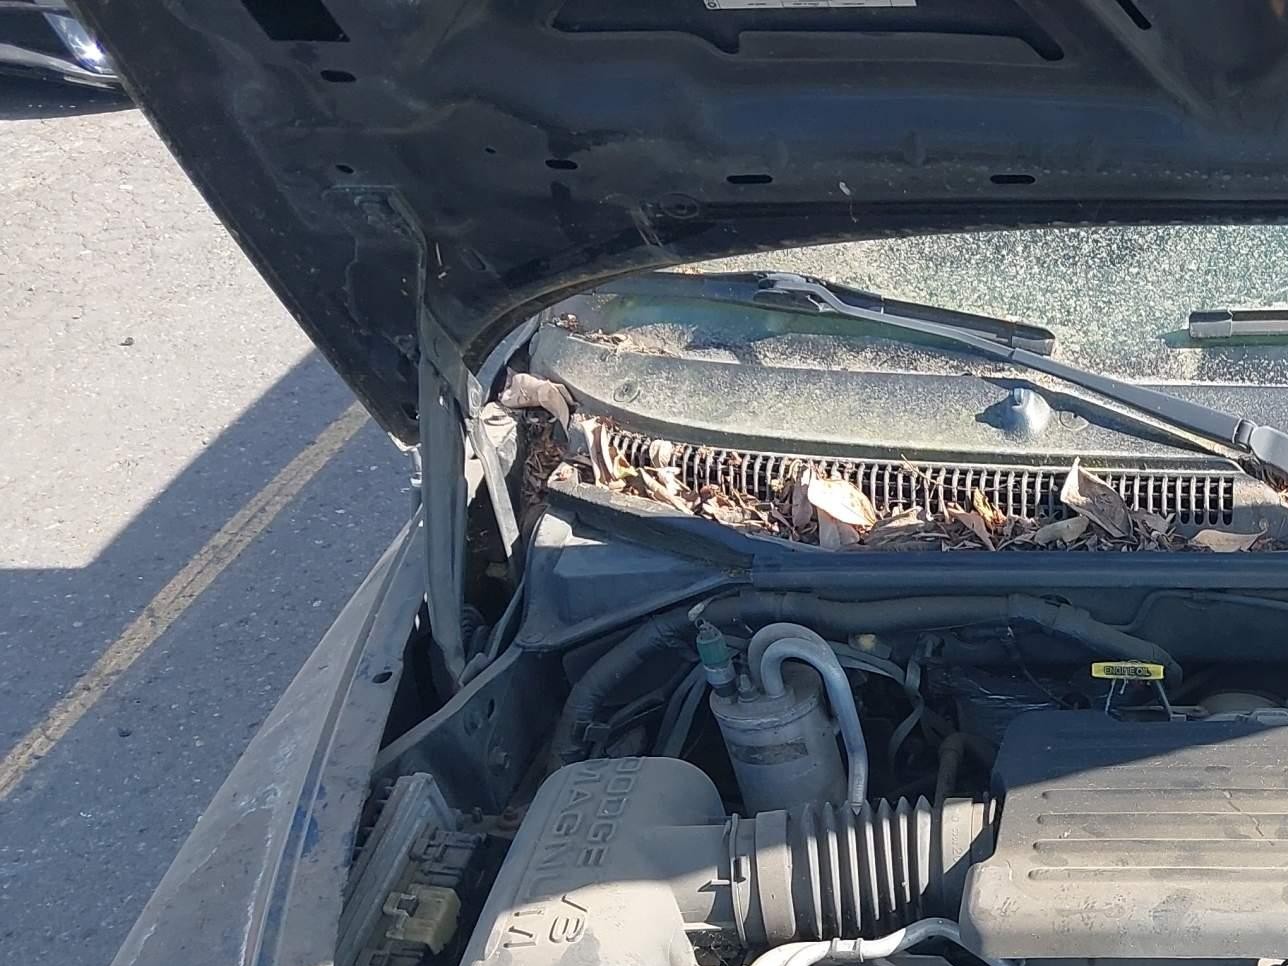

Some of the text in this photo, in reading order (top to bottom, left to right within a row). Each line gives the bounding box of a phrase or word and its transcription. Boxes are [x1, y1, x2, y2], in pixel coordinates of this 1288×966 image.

[1103, 665, 1152, 677] ENGINE OIL
[503, 758, 611, 949] MAGNUM
[576, 756, 645, 868] DODGE
